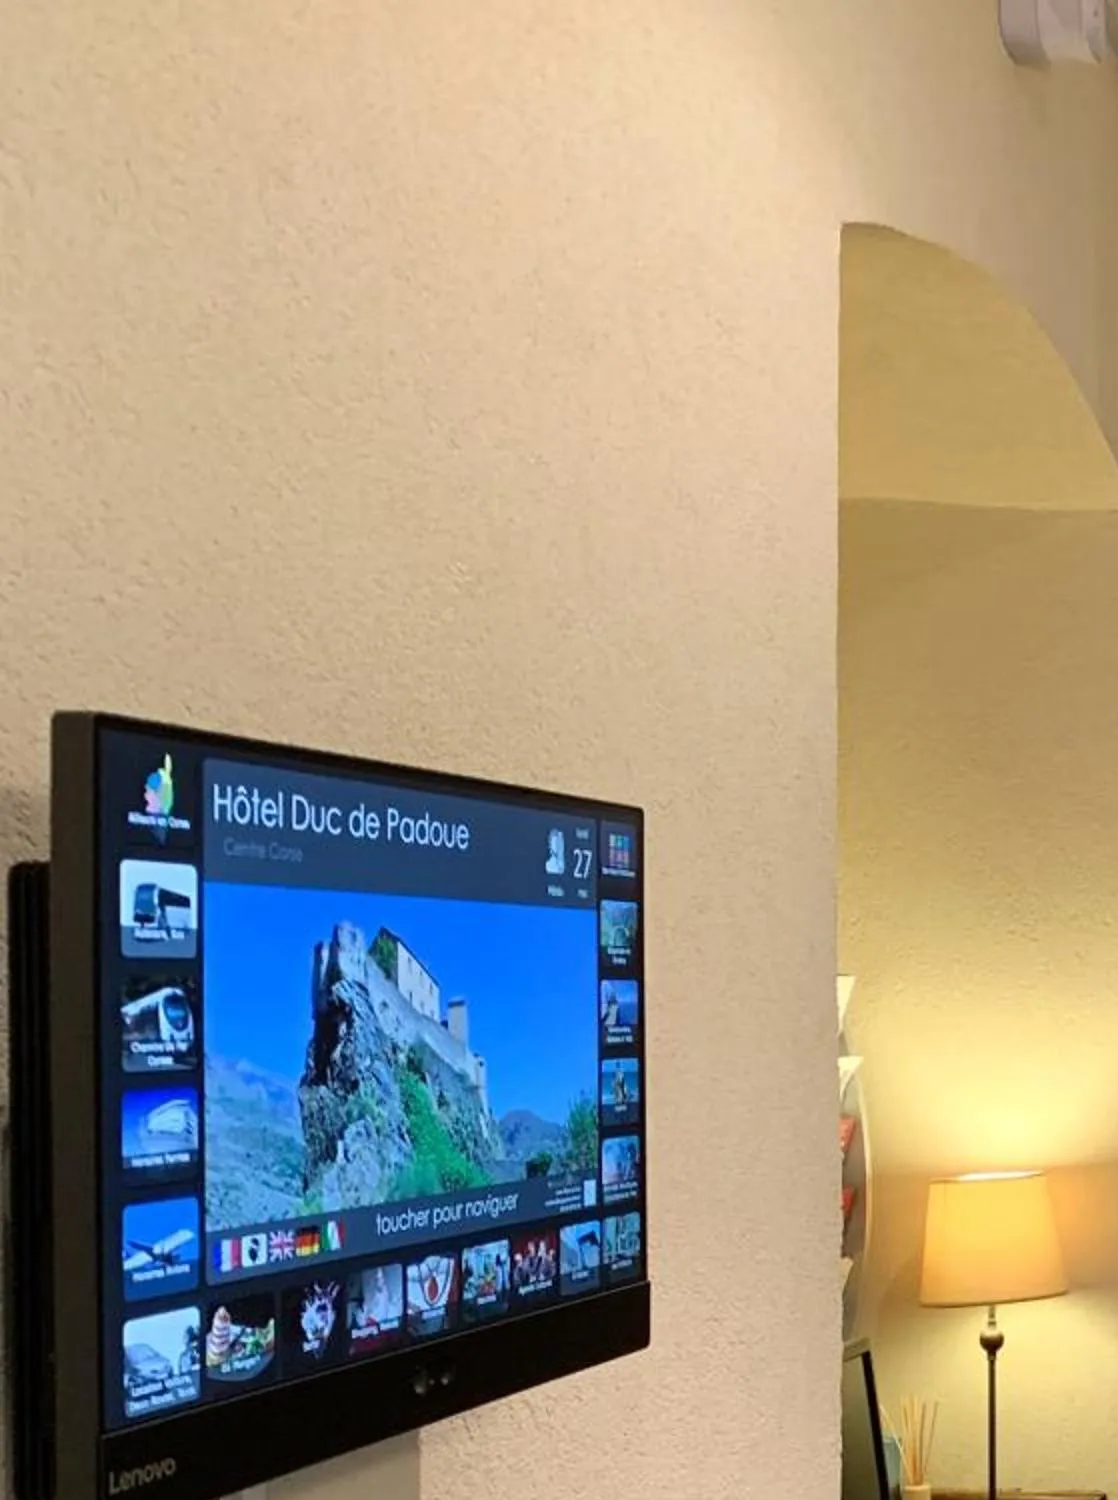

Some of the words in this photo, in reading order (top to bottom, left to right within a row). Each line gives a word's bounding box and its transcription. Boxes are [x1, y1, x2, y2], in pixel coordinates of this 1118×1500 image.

[213, 783, 284, 829] Hôtel
[291, 794, 342, 836] Duc
[349, 803, 380, 840] de
[387, 807, 470, 850] Padoue
[573, 849, 592, 879] 27
[375, 1207, 430, 1237] toucher
[433, 1200, 464, 1229] pour
[465, 1192, 519, 1218] naviguer
[108, 1457, 176, 1496] Lenovo
